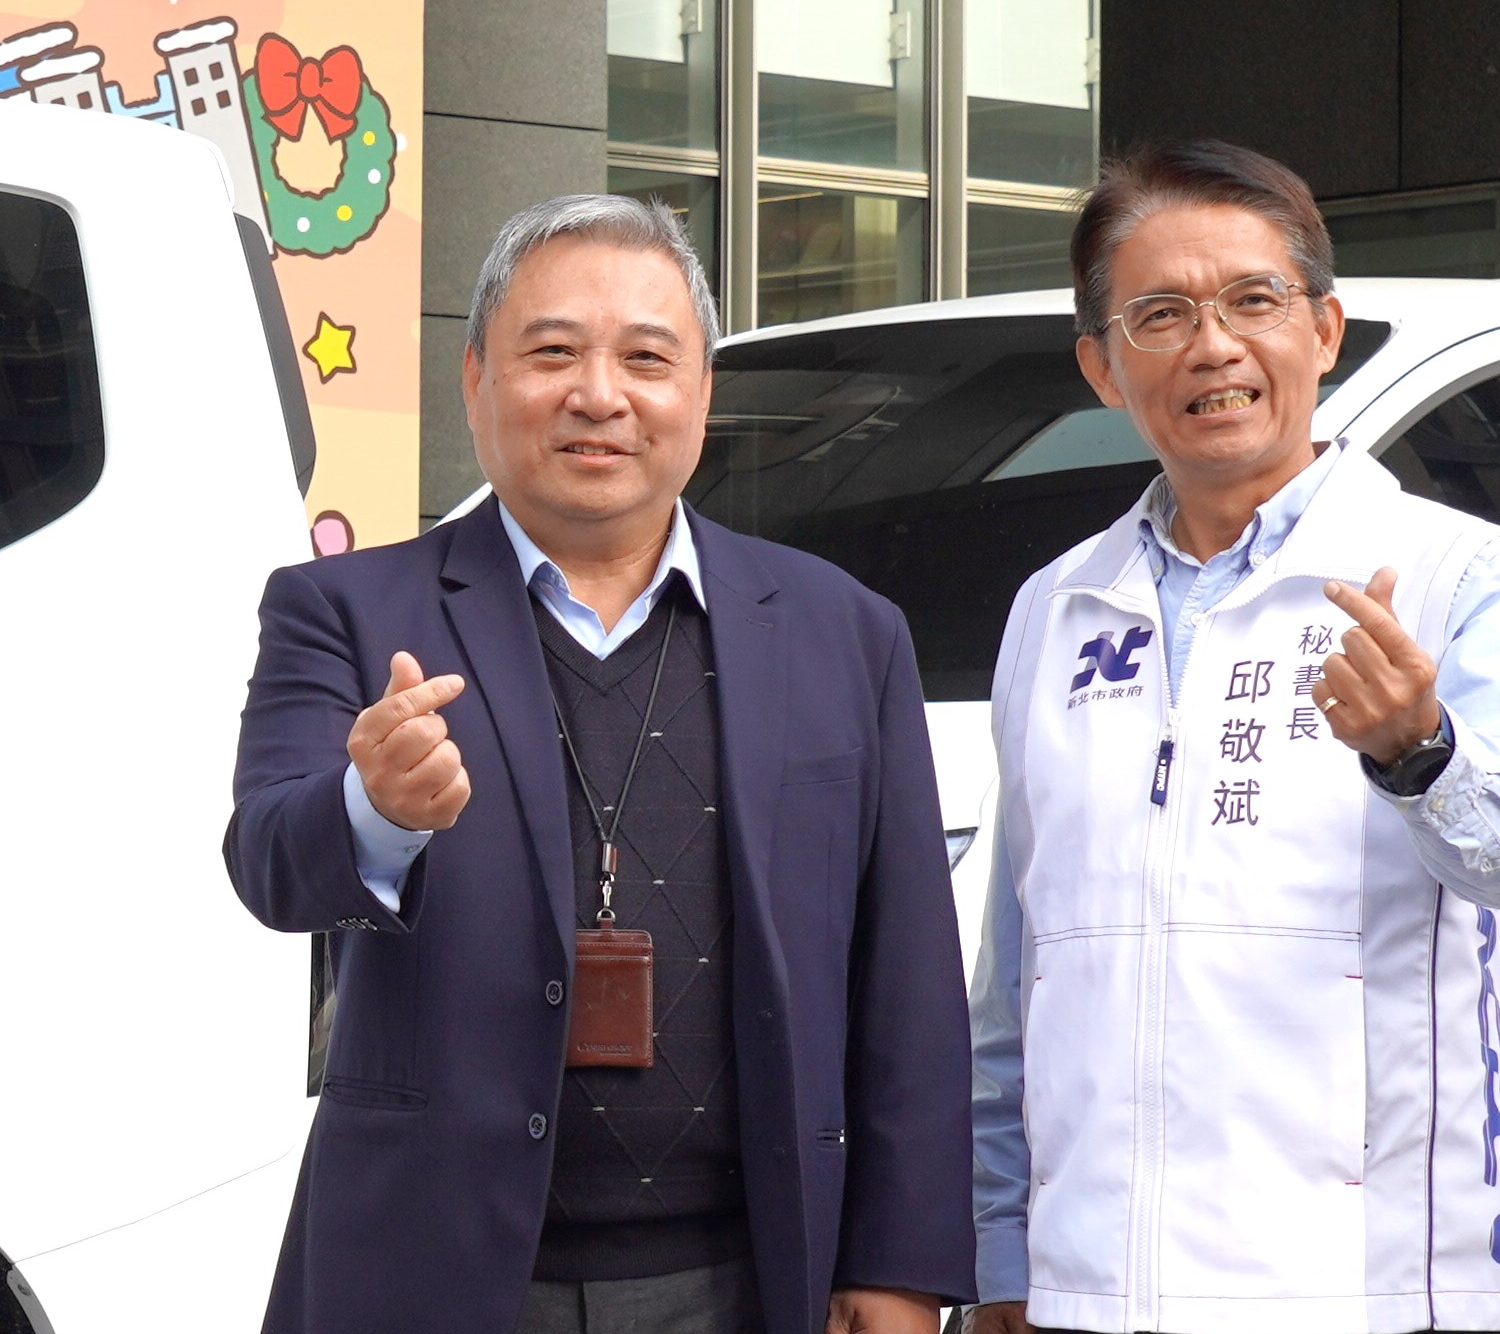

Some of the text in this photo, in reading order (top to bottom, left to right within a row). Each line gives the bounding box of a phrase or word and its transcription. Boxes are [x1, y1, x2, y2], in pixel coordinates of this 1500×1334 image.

[1067, 685, 1144, 710] 新北市政府
[1286, 624, 1334, 741] 秘書長
[1211, 660, 1276, 827] 邱敬斌
